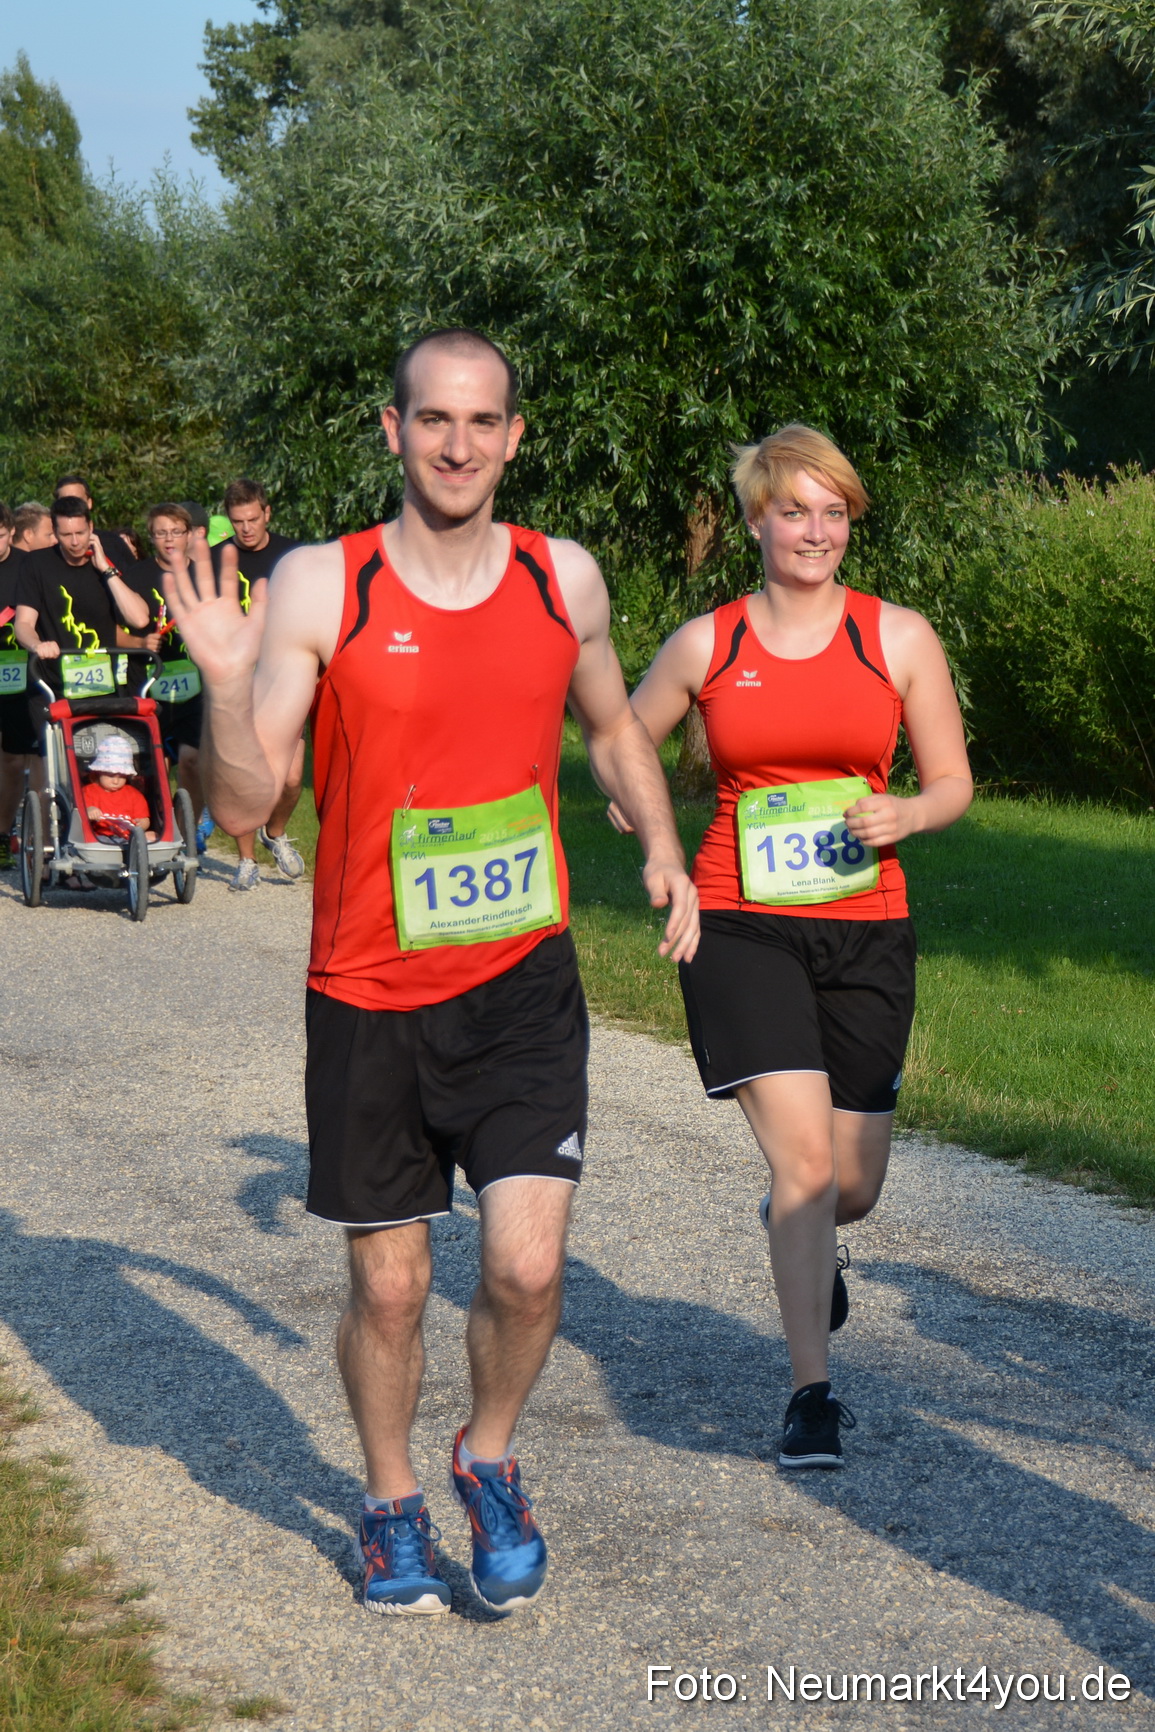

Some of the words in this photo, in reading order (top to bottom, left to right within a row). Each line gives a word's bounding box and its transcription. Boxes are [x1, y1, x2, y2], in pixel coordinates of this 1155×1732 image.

[388, 643, 420, 653] erima
[0, 667, 21, 682] 52
[74, 667, 105, 686] 243
[735, 679, 762, 687] erima
[159, 676, 189, 695] 241
[759, 802, 806, 816] firmenlauf
[418, 828, 478, 845] firmenlauf
[756, 828, 866, 873] 1388
[414, 846, 539, 911] 1387
[791, 879, 812, 888] Lena
[812, 875, 837, 886] Blank
[429, 914, 482, 930] Alexander
[482, 902, 533, 923] Rindfleisch
